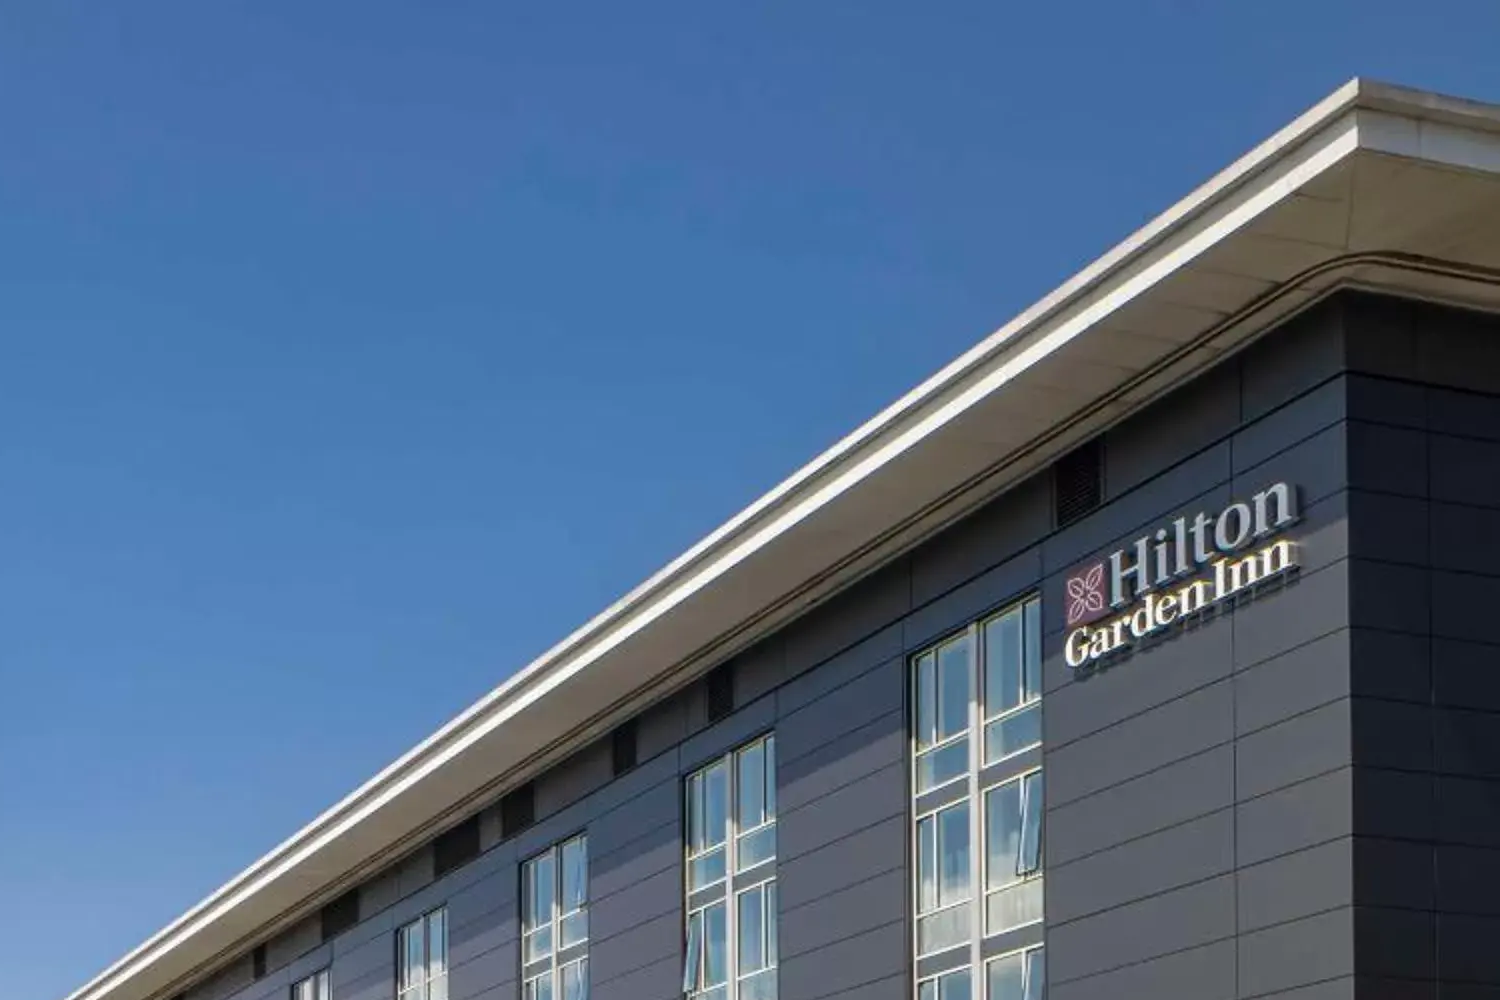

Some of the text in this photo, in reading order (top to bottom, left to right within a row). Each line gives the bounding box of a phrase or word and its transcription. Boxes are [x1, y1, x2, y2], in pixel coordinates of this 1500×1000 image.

[1065, 540, 1294, 667] Garden Inn
[1109, 481, 1293, 607] Hilton
